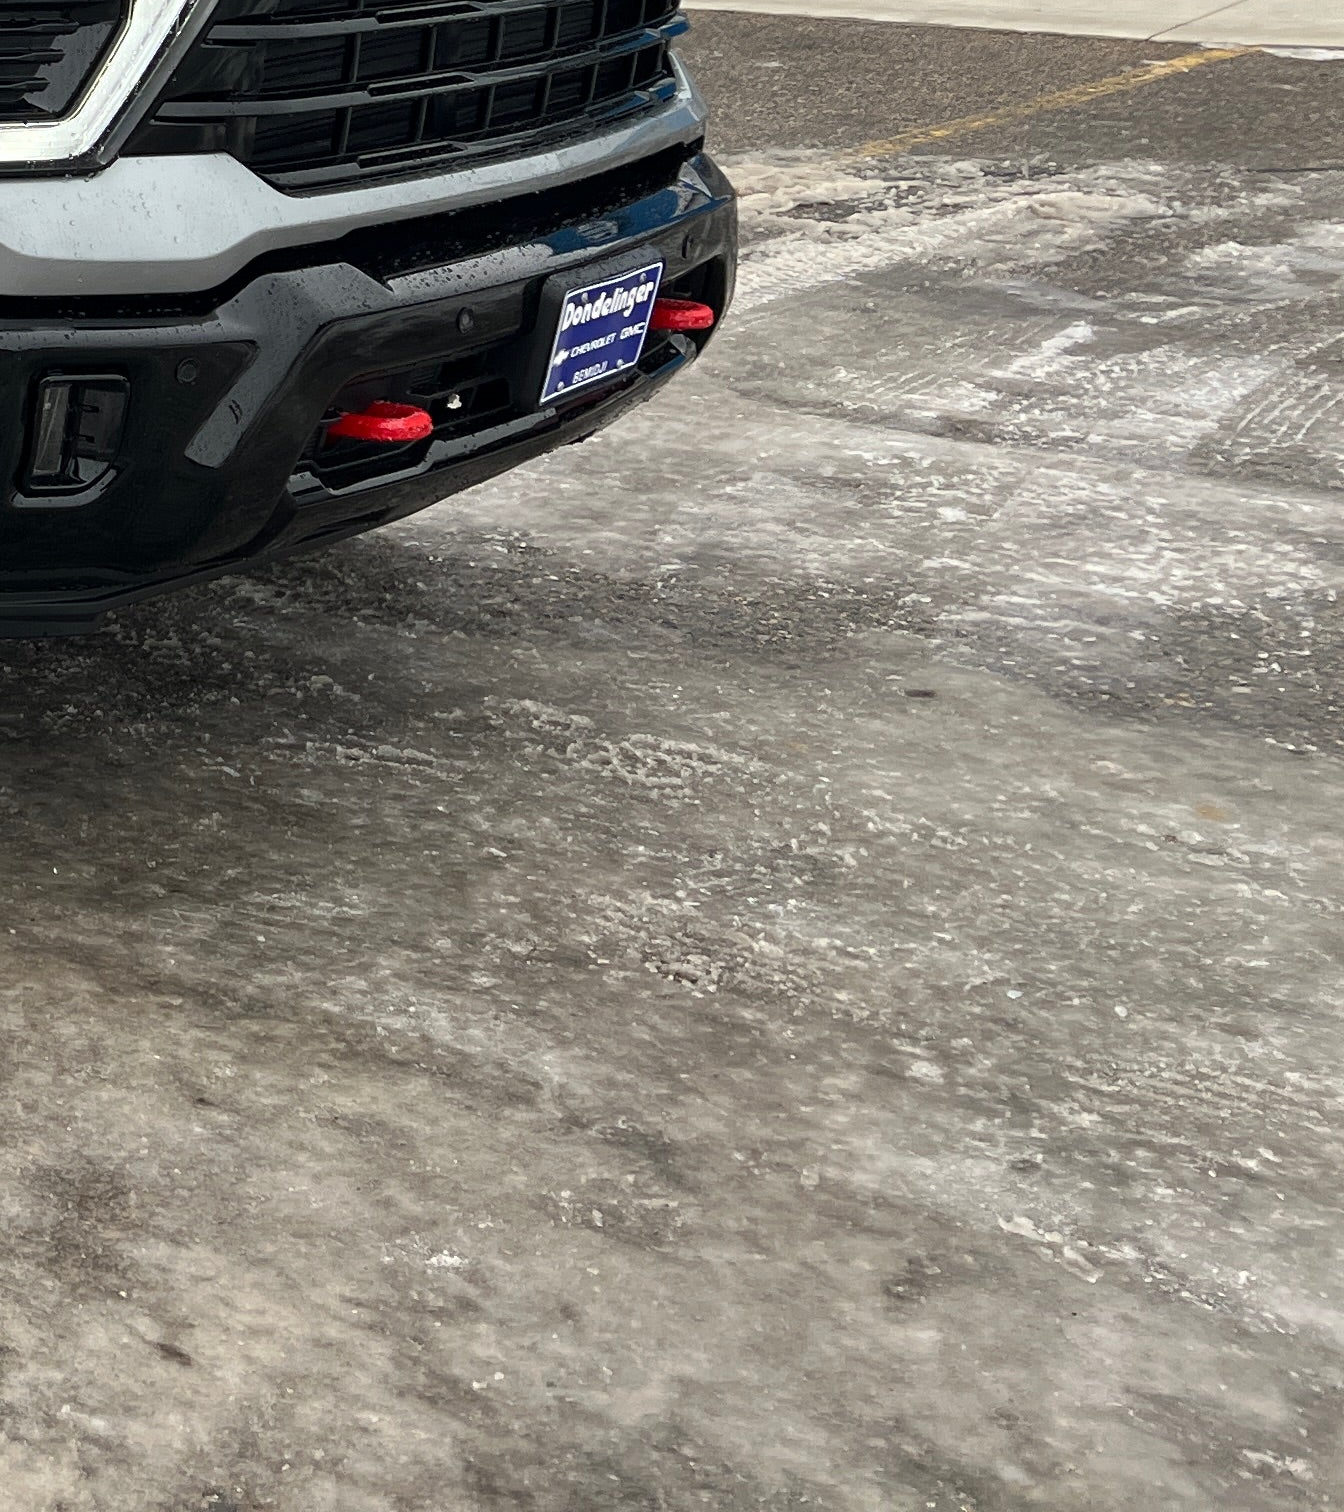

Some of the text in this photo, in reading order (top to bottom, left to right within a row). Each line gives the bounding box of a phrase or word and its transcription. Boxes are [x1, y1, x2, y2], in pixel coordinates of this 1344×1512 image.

[561, 281, 654, 331] Dondelinger
[570, 321, 646, 358] CHEVROLET GMC
[572, 360, 608, 384] BEMIDJI
